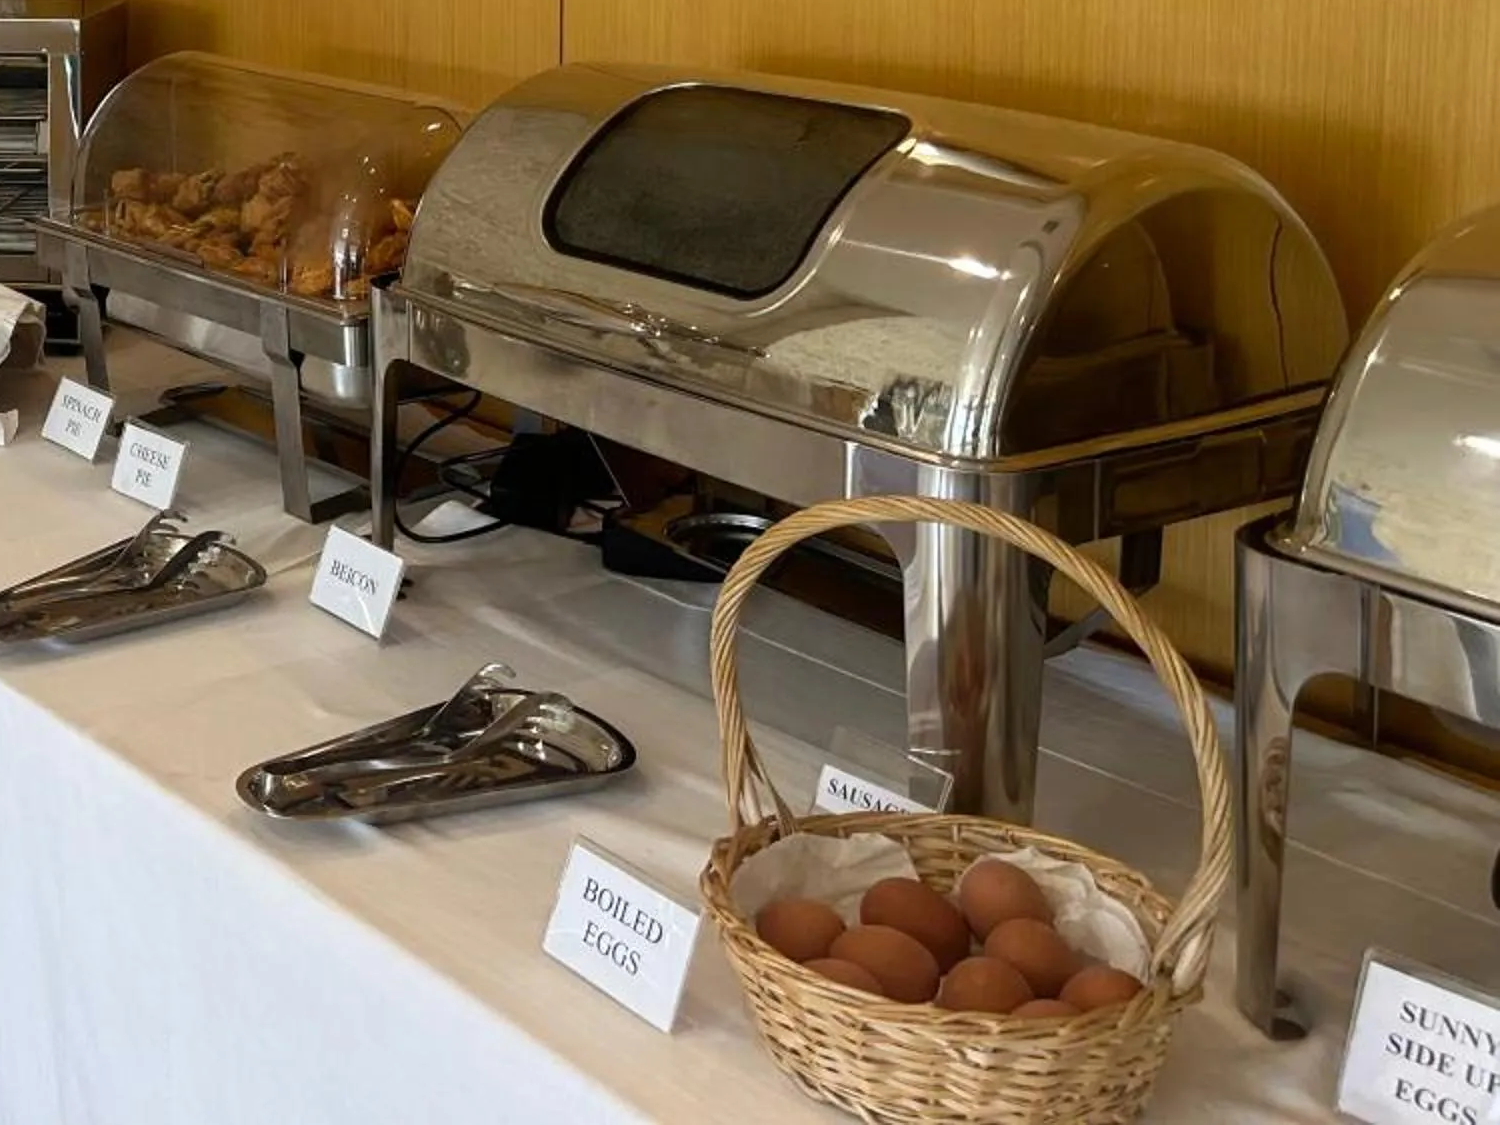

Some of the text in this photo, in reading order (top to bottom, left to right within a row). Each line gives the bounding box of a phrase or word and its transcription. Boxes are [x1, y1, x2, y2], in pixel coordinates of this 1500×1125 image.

[62, 393, 103, 424] SPINACH
[65, 418, 84, 437] PIE
[130, 442, 171, 470] CHEESE
[135, 468, 153, 488] PIE
[330, 559, 379, 596] BEICON
[582, 877, 664, 944] BOILED
[582, 920, 642, 976] EGGS
[1400, 1000, 1500, 1056] SUNNY
[1385, 1032, 1456, 1078] SIDE
[1395, 1078, 1479, 1125] EGGS
